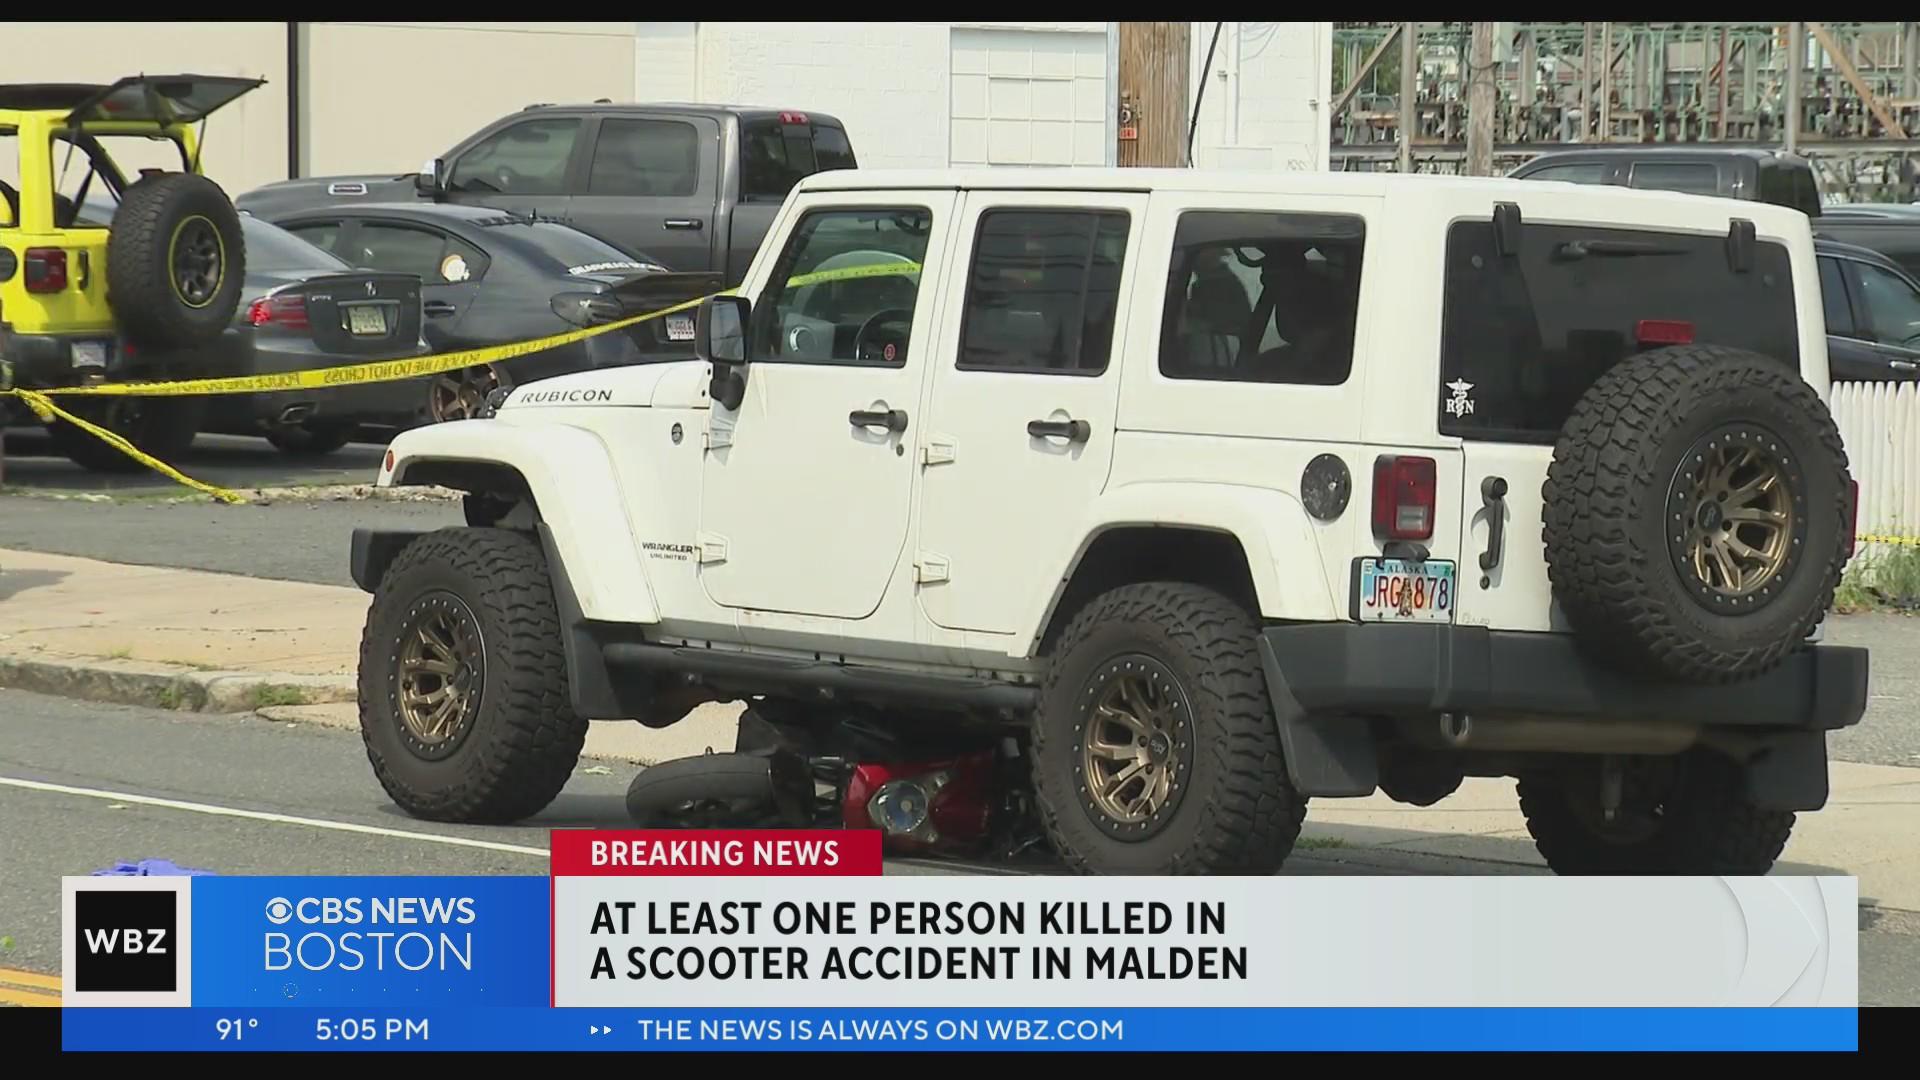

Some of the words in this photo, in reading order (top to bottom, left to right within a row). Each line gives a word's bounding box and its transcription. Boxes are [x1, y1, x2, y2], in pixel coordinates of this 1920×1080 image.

[521, 389, 613, 403] RUBICON
[641, 541, 694, 554] WRANGLER
[1387, 564, 1429, 575] ALASKA
